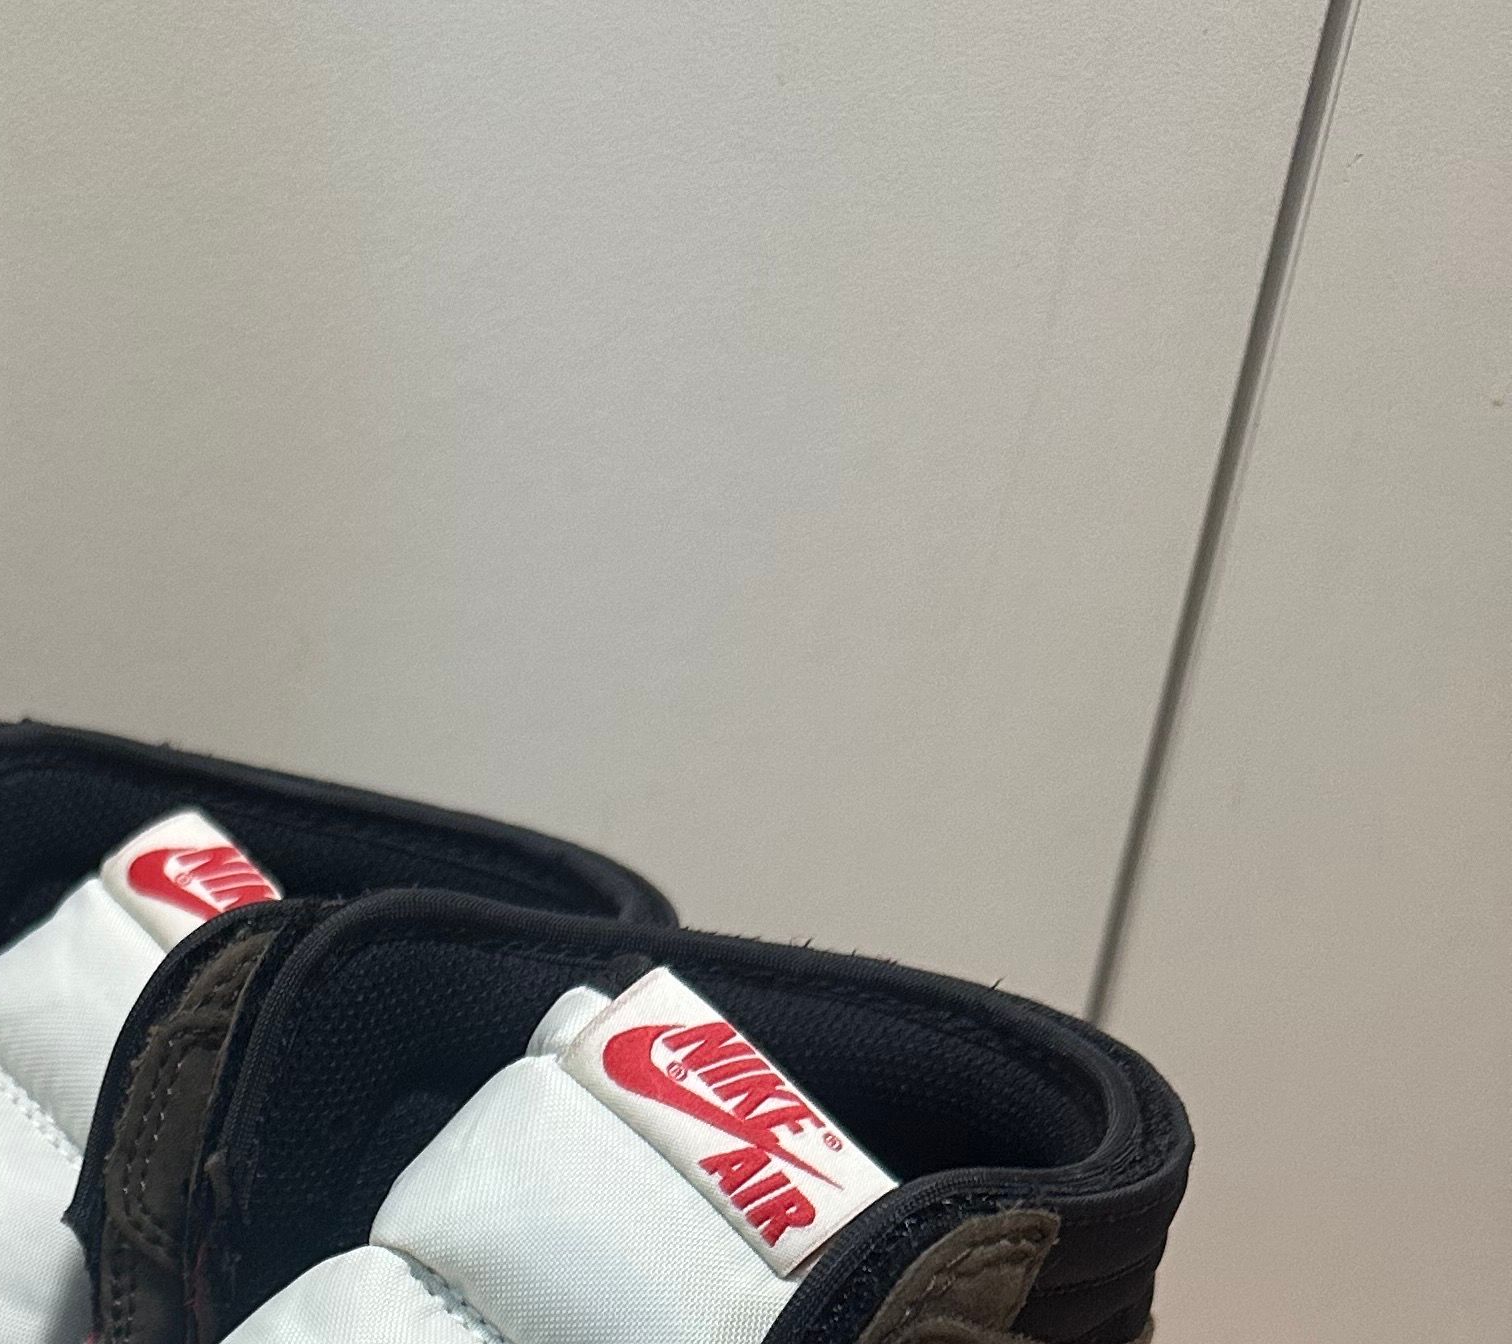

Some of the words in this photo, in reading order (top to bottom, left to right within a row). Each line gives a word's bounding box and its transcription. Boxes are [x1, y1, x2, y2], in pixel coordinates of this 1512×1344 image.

[177, 847, 273, 911] NIK
[662, 1022, 825, 1144] NIKE
[698, 1147, 816, 1248] AIR
